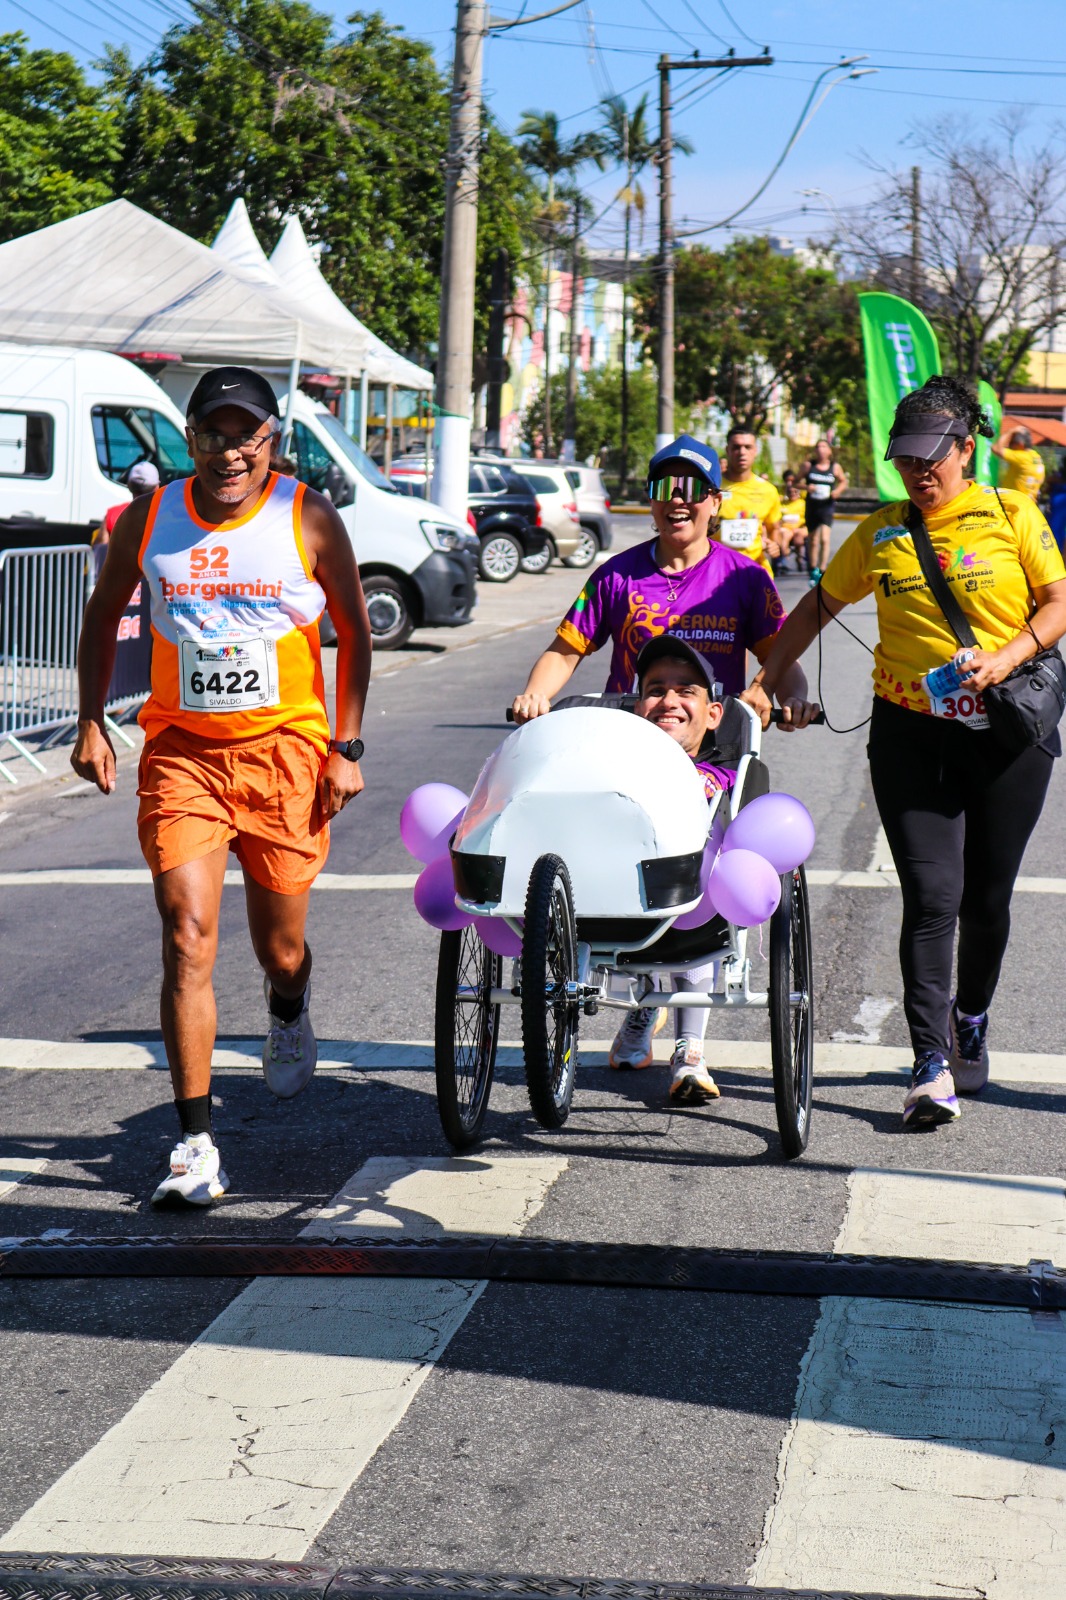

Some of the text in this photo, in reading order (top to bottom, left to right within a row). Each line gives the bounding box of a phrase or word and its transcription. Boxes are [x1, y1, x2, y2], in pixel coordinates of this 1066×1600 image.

[190, 546, 229, 570] 52
[158, 577, 283, 601] bergamini
[891, 575, 922, 586] Corrida
[898, 582, 930, 593] Caminh
[957, 570, 994, 580] Inclusão
[668, 614, 738, 632] PERNAS
[668, 628, 736, 641] SOLIDÁRIAS
[190, 669, 261, 695] 6422
[209, 698, 241, 706] SIVALDO
